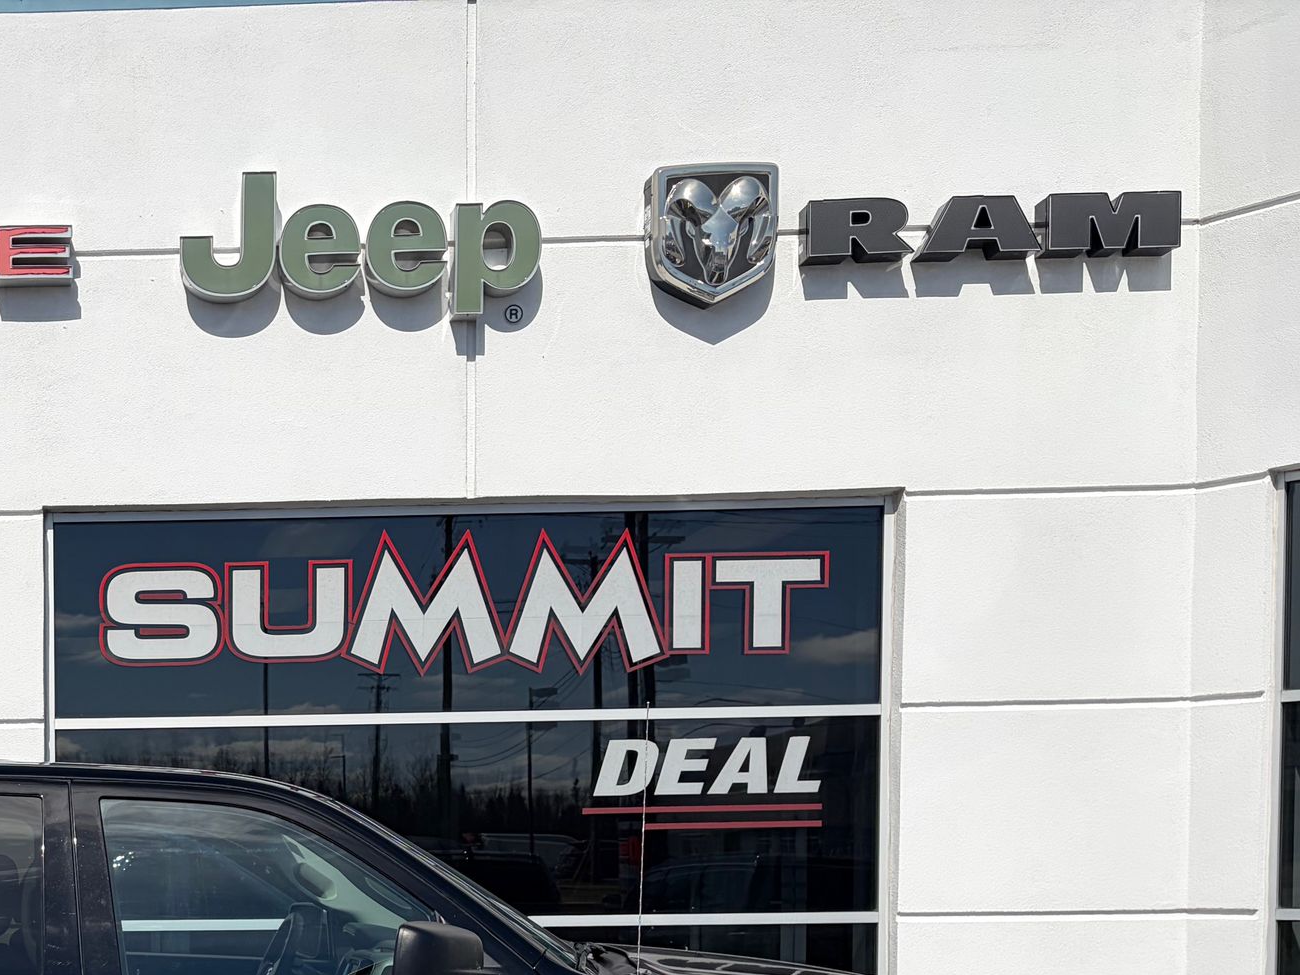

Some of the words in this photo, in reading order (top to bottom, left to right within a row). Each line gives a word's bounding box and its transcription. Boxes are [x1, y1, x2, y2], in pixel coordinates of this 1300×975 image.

[180, 171, 543, 318] Jeep
[799, 190, 1182, 266] RAM
[99, 528, 831, 677] SUMMIT
[592, 735, 823, 797] DEAL
